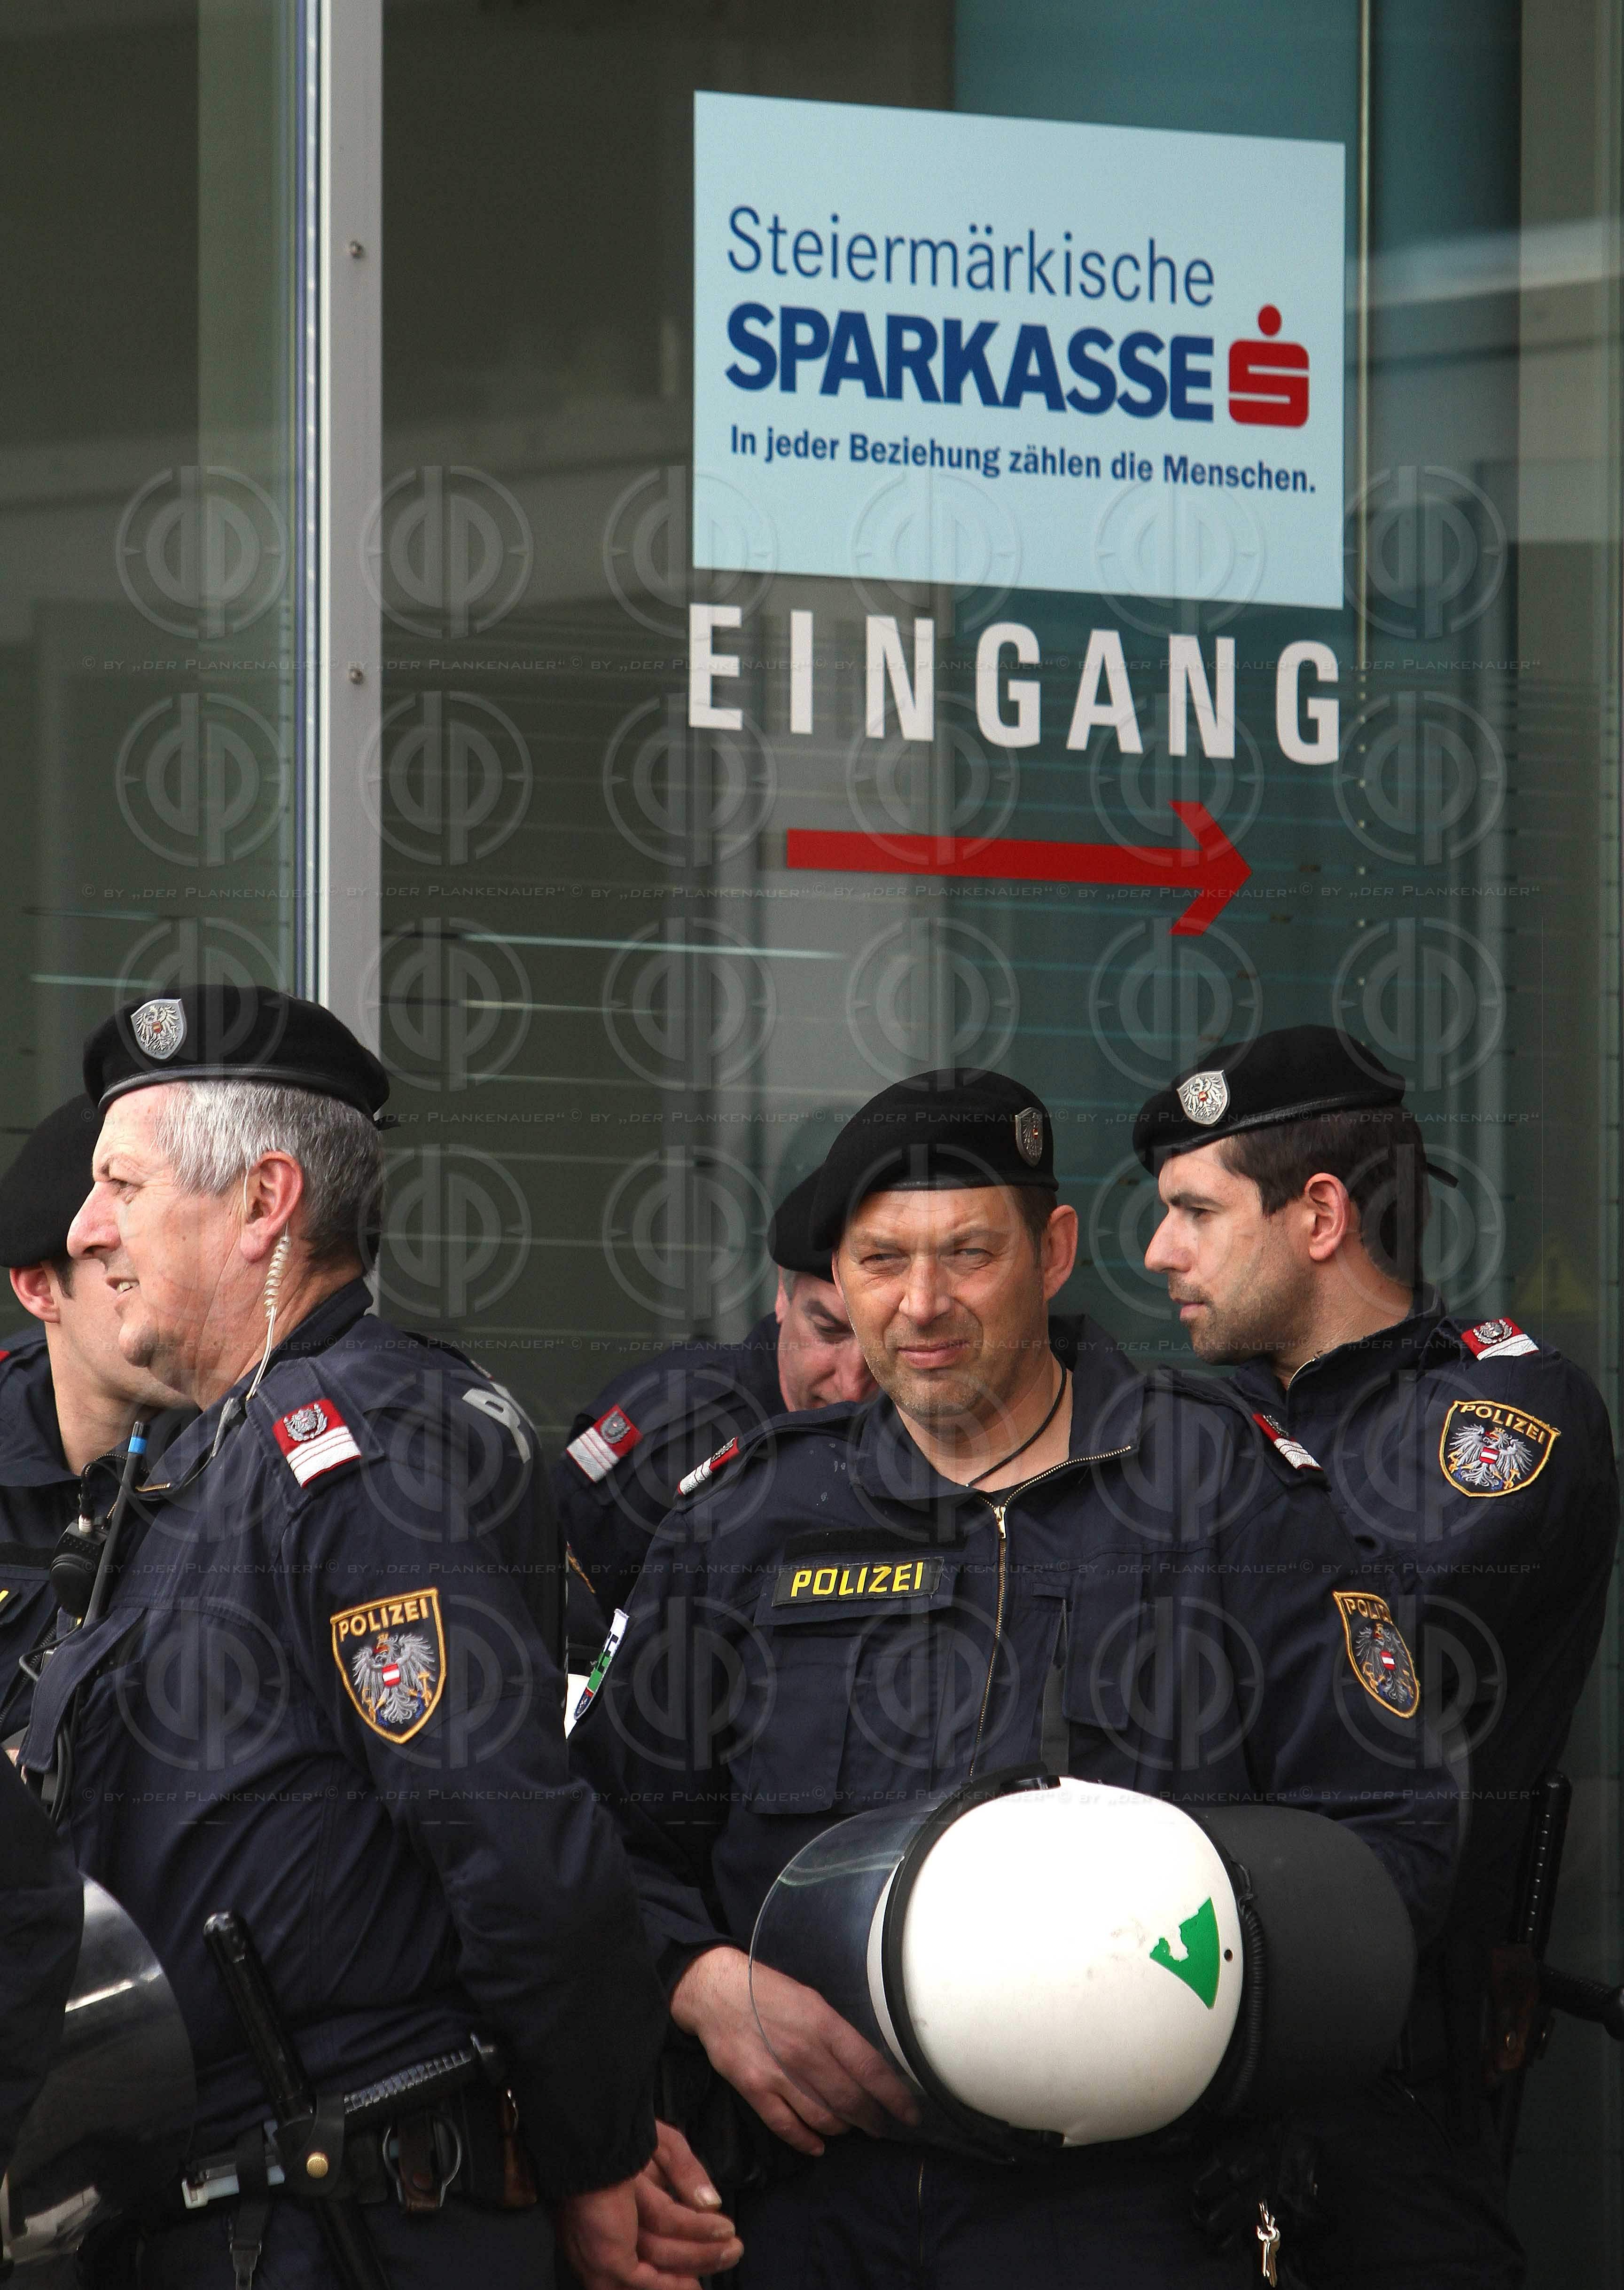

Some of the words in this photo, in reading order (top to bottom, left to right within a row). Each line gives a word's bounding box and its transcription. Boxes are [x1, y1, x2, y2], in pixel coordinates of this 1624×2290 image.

[726, 205, 1215, 308] Steiermärkische
[725, 301, 1214, 423] SPARKASSE
[731, 424, 757, 455] In
[765, 426, 840, 464] jeder
[849, 433, 1001, 479] Beziehung
[1008, 444, 1101, 479] zählen
[1110, 451, 1153, 483] die
[1163, 455, 1316, 493] Menschen.
[689, 603, 1340, 765] EINGANG
[1460, 1404, 1546, 1444] POLIZEI
[790, 1561, 924, 1598] POLIZEI
[338, 1598, 429, 1643] POLIZEI
